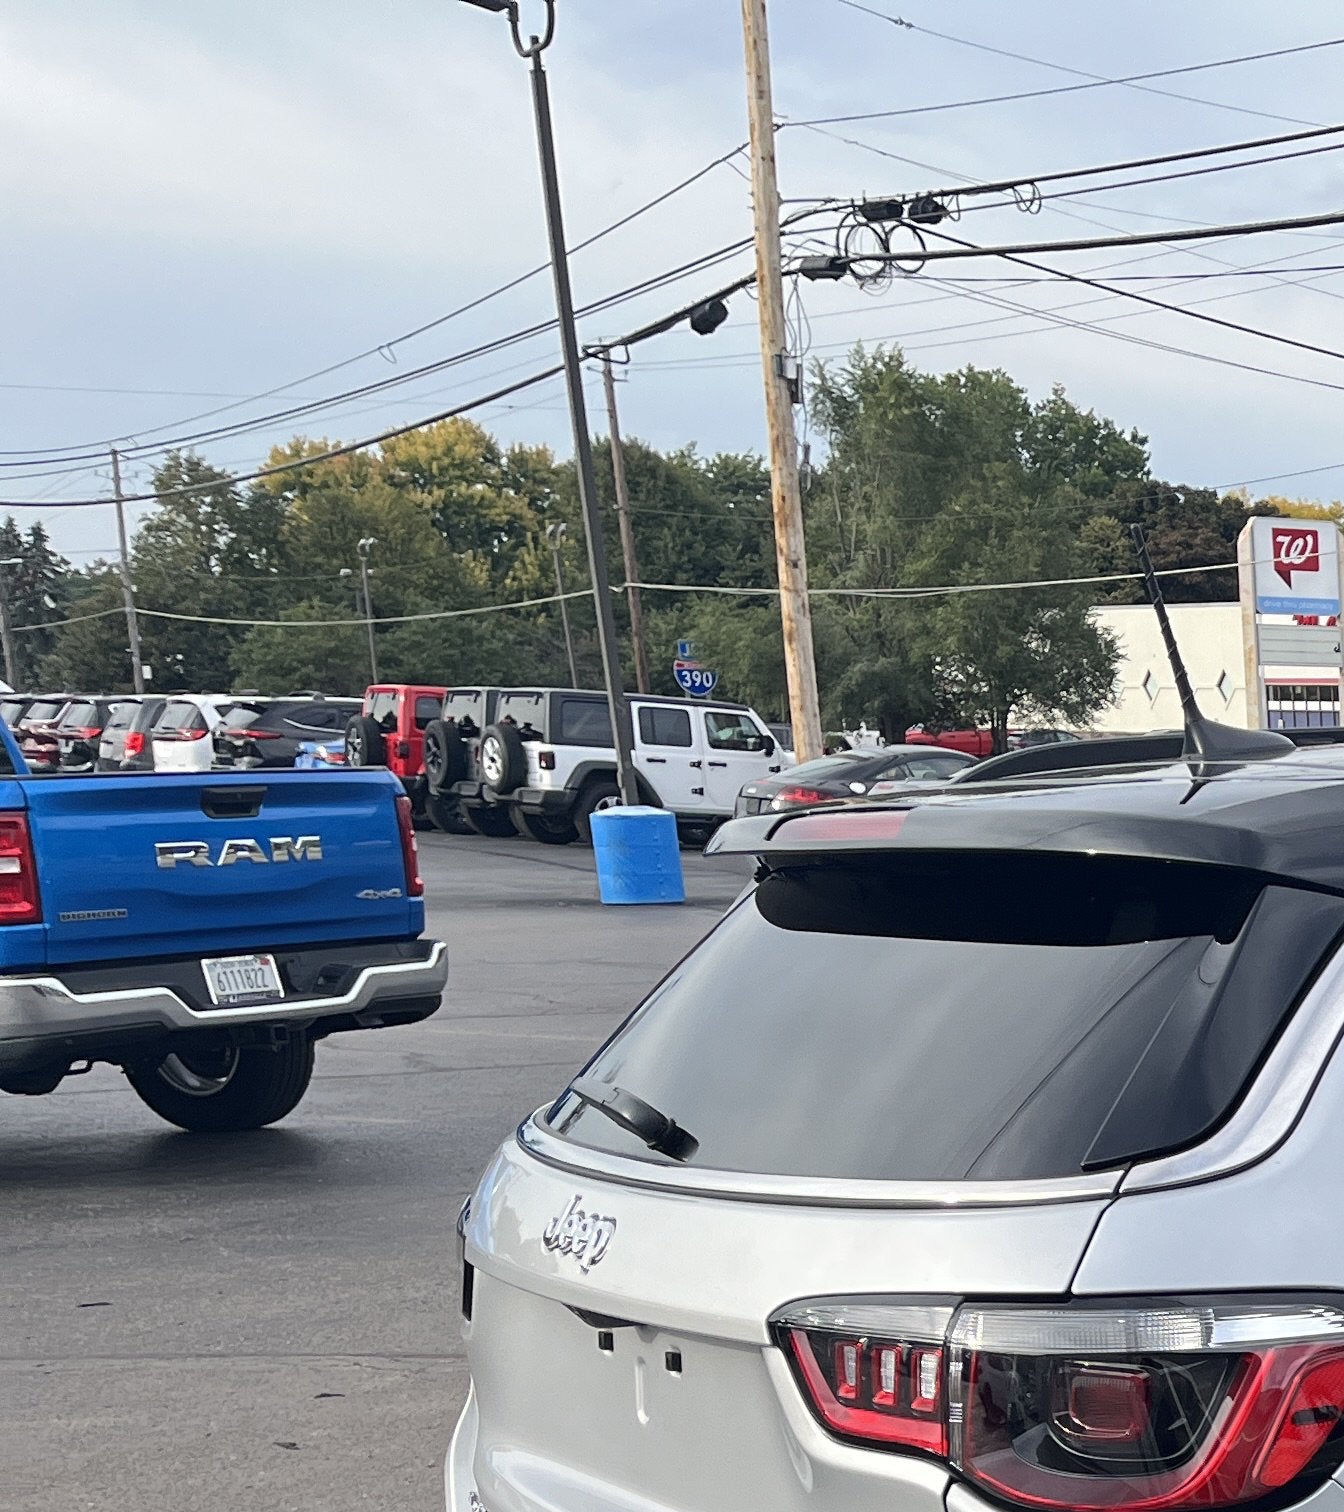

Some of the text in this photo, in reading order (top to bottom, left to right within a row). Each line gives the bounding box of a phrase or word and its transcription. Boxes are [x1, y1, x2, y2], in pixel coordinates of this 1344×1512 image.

[1276, 534, 1314, 564] W
[682, 670, 713, 688] 390
[155, 835, 323, 868] RAM
[217, 968, 269, 992] 6111822
[542, 1194, 617, 1275] Jeep
